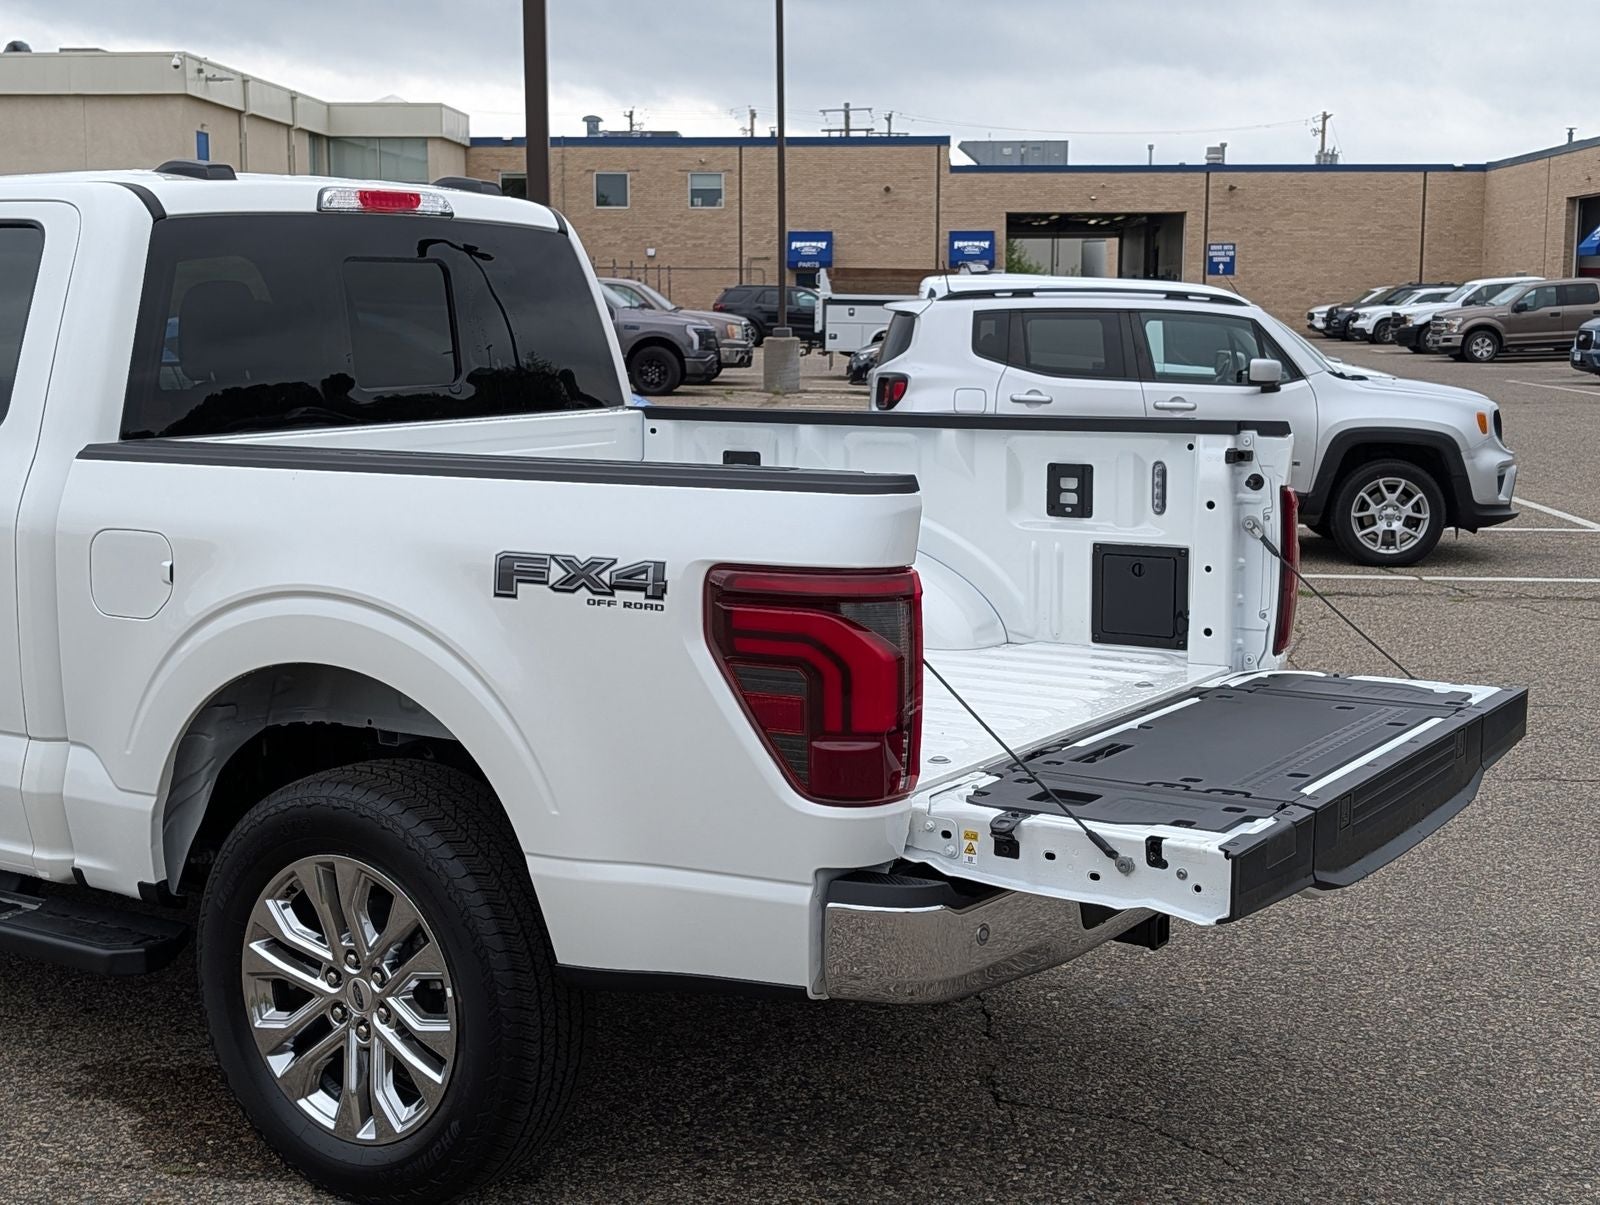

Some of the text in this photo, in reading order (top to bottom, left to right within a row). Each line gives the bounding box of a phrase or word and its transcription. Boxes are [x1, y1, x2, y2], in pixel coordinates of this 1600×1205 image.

[493, 551, 668, 601] FX4
[586, 598, 665, 612] OFF ROAD
